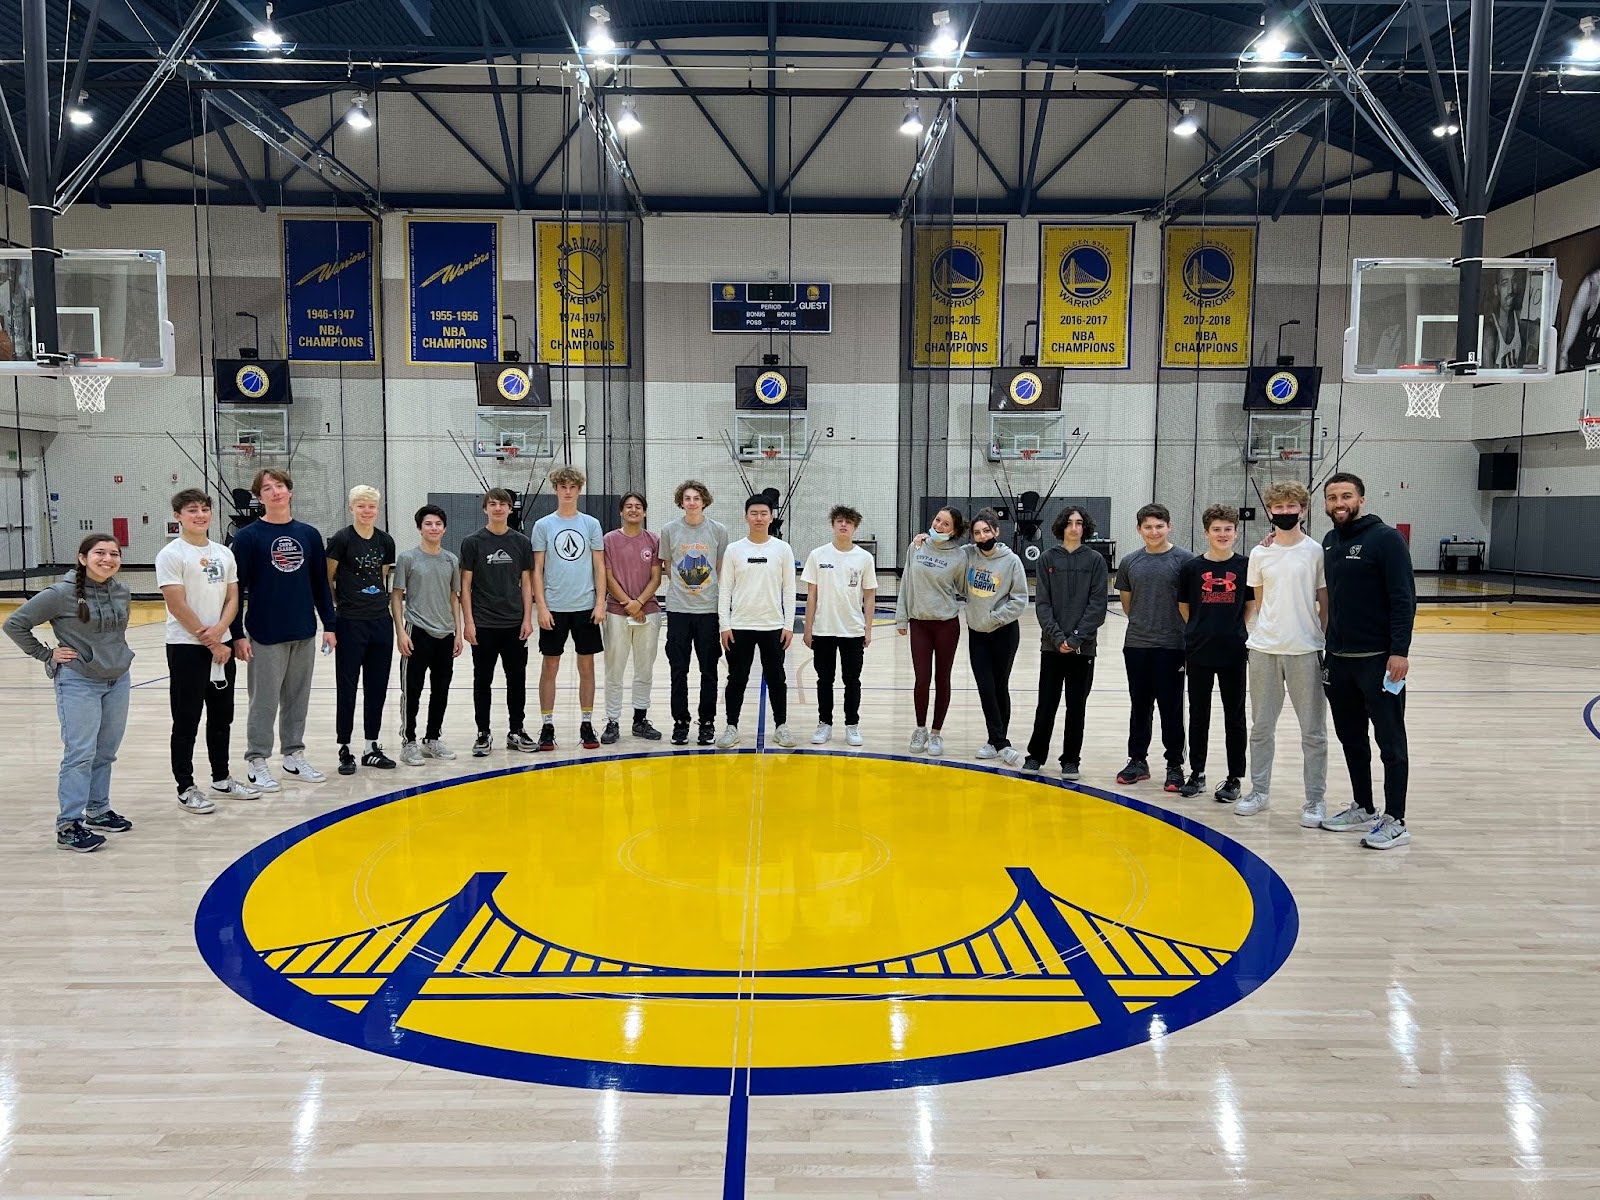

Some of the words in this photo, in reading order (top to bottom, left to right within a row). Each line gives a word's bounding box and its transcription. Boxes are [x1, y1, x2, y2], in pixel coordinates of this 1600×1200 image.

[964, 240, 985, 257] STATE
[1059, 239, 1089, 257] GOLDEN
[1092, 240, 1113, 257] STATE
[1182, 240, 1212, 258] GOLDEN
[1215, 240, 1236, 257] STATE
[294, 251, 366, 286] Warriors
[419, 252, 489, 287] Warriors
[932, 288, 985, 308] WARRIORS
[1059, 288, 1113, 308] WARRIORS
[1182, 288, 1236, 308] WARRIORS
[798, 301, 828, 310] GUEST
[306, 308, 355, 320] 1946-1947
[430, 310, 479, 321] 1955-1956
[559, 313, 606, 323] 1974-1975
[933, 315, 981, 325] 2014-2015
[1060, 315, 1108, 325] 2016-2017
[1183, 315, 1231, 325] 2017-2018
[318, 324, 343, 336] NBA
[442, 326, 467, 337] NBA
[571, 328, 595, 338] NBA
[298, 336, 364, 347] CHAMPIONS
[945, 331, 968, 341] NBA
[1072, 331, 1095, 341] NBA
[1195, 331, 1218, 341] NBA
[422, 337, 488, 349] CHAMPIONS
[550, 339, 615, 351] CHAMPIONS
[924, 342, 988, 353] CHAMPIONS
[1051, 342, 1115, 353] CHAMPIONS
[1174, 342, 1238, 353] CHAMPIONS
[325, 422, 331, 433] 1
[577, 425, 586, 436] 2
[826, 427, 834, 438] 3
[1071, 427, 1081, 436] 4
[934, 558, 948, 568] RICA
[974, 571, 991, 582] FALL
[973, 580, 996, 593] BRAWL
